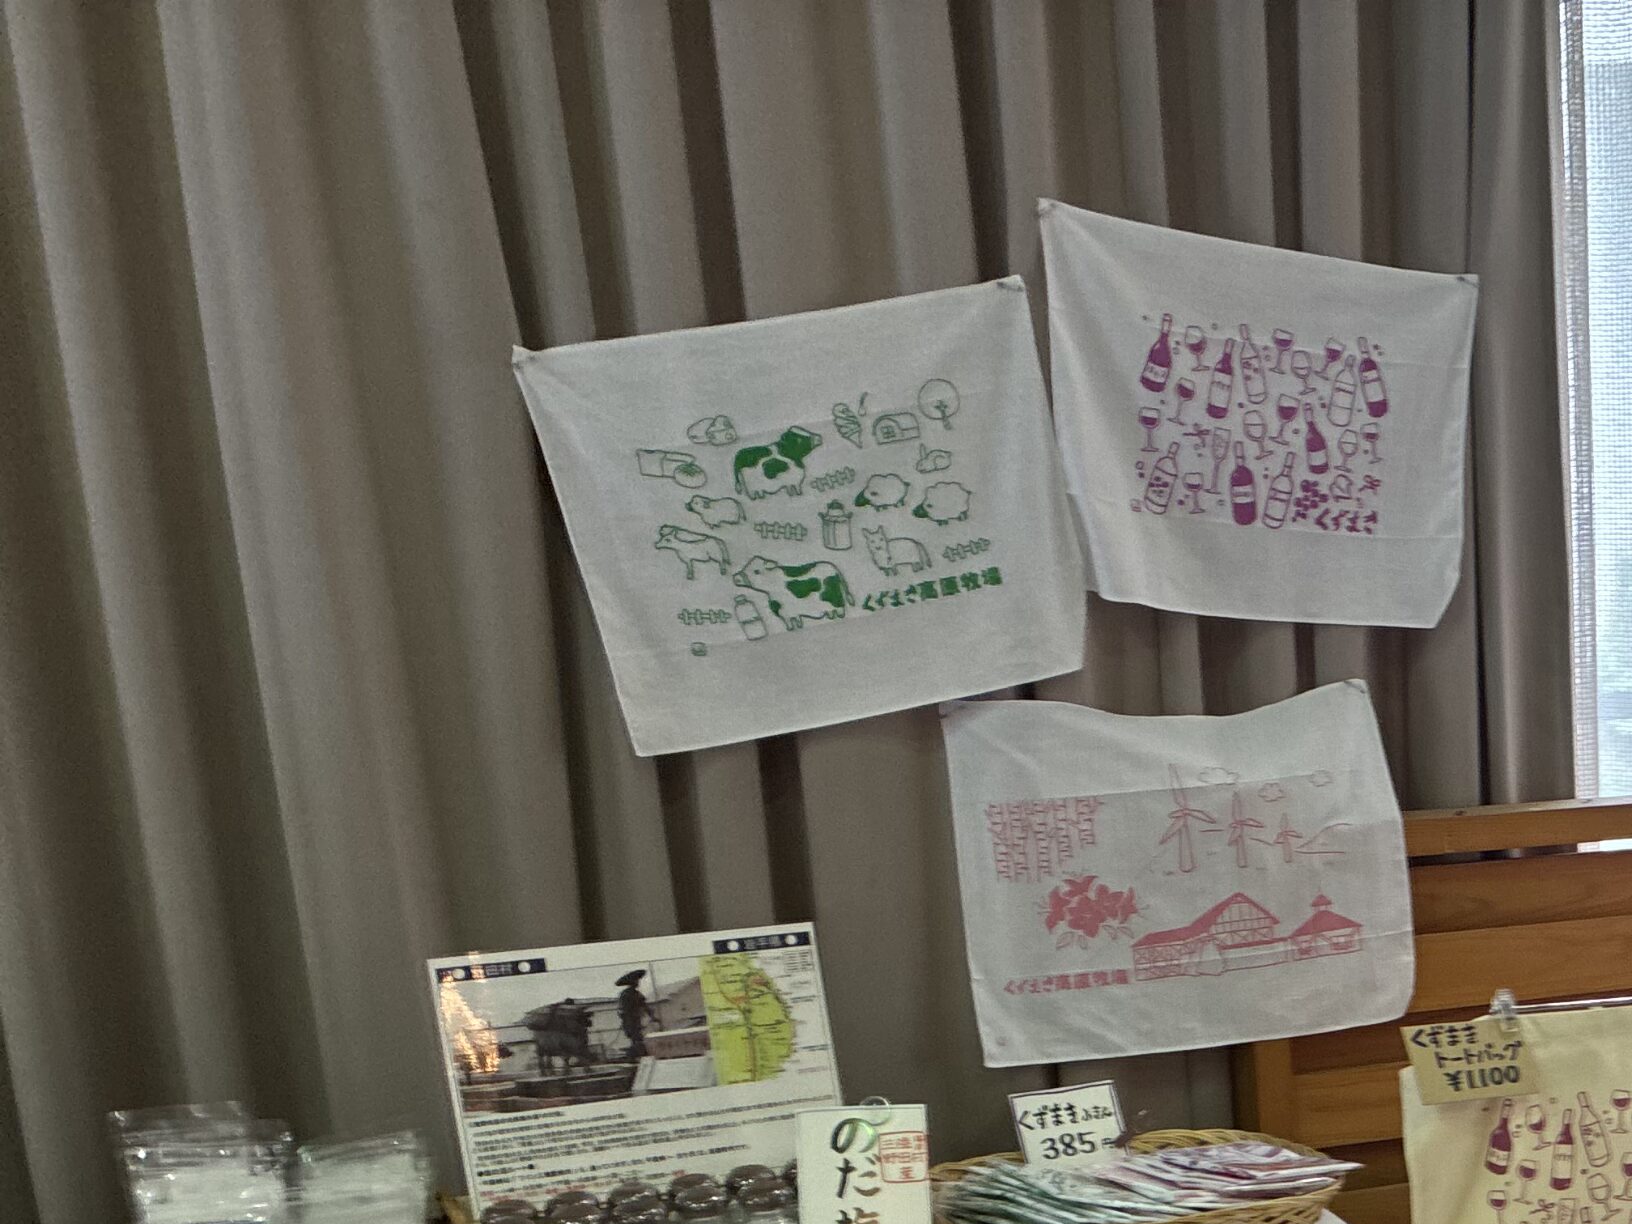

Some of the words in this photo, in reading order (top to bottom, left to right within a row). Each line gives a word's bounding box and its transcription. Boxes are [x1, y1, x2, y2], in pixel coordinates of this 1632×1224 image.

[1409, 1023, 1480, 1048] くずまき
[1434, 1040, 1524, 1069] トートバッグ
[1442, 1065, 1520, 1092] ¥1100
